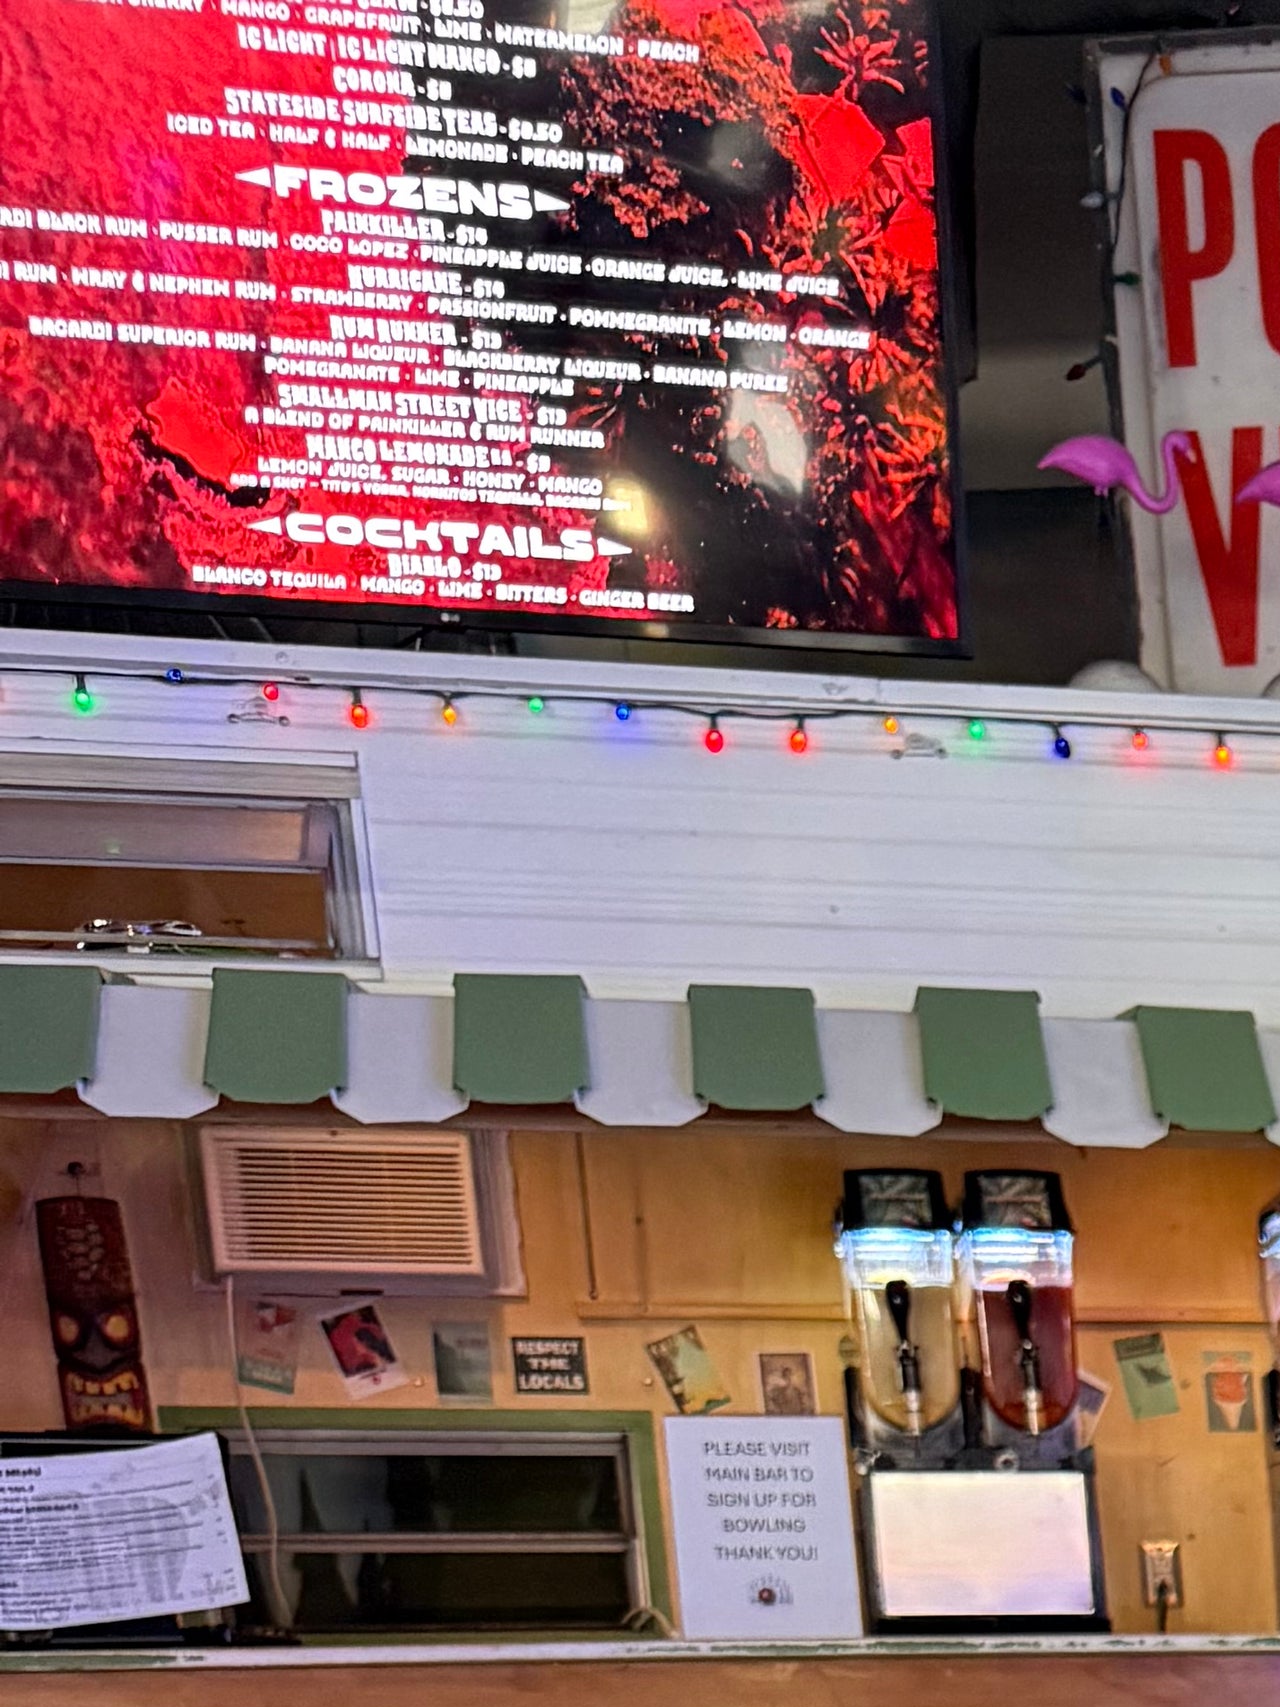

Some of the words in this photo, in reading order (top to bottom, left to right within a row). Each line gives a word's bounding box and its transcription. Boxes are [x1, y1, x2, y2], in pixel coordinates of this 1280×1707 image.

[220, 0, 290, 21] MANGO
[305, 7, 421, 35] GRAPEFRUIT
[434, 18, 482, 41] LIME
[495, 21, 623, 56] WATERMELON
[638, 38, 699, 63] PEACH
[263, 24, 327, 57] LIGHT
[363, 37, 426, 68] LIGHT
[427, 41, 501, 75] MANGO
[333, 65, 416, 98] CORONA
[223, 86, 342, 122] STATESIDE
[342, 99, 443, 132] SURFSIDE
[443, 107, 498, 137] TEAS
[166, 111, 213, 136] ICED
[217, 116, 256, 140] TEA
[269, 121, 319, 145] HALF
[342, 130, 391, 152] HALF
[405, 135, 508, 164] LEMONADE
[522, 146, 583, 170] PEACH
[587, 151, 624, 175] TEA
[273, 163, 534, 220] FROZENS
[321, 208, 446, 243] PAINKILLER
[37, 208, 101, 235] BLACK
[104, 215, 148, 238] RUM
[159, 219, 233, 245] PUSSER
[236, 226, 278, 249] RUM
[290, 233, 343, 254] COCO
[348, 238, 409, 260] LOPEZ
[421, 245, 523, 270] PINEAPPLE
[526, 251, 582, 275] JUICE
[592, 257, 665, 282] ORANGE
[738, 271, 782, 292] LIME
[786, 273, 839, 296] JUICE
[347, 265, 462, 295] HURRICANE
[13, 260, 57, 284] RUM
[71, 265, 127, 290] WRAY
[149, 272, 230, 298] NEPHEW
[234, 280, 277, 301] RUM
[291, 285, 412, 312] STRAWBERRY
[428, 296, 557, 323] PASSIONFRUIT
[570, 306, 711, 336] POMMEGRANITE
[723, 319, 787, 342] LEMON
[799, 326, 871, 350] ORANGE
[329, 314, 374, 341] RUM
[376, 318, 458, 347] RUNNER
[28, 314, 113, 341] BACARDI
[116, 322, 210, 348] SUPERIOR
[214, 330, 257, 352] RUM
[270, 335, 347, 359] BANANA
[352, 341, 430, 365] LIQUEUR
[443, 348, 560, 376] BLACKBERRY
[564, 357, 642, 383] LIQUEUR
[653, 363, 727, 389] BANANA
[730, 371, 788, 392] PUREE
[264, 354, 401, 384] POMEGRANATE
[414, 367, 460, 389] LIME
[473, 371, 574, 397] PINEAPPLE
[278, 383, 393, 413] SMALLMAN
[395, 391, 471, 418] STREET
[472, 395, 522, 424] VICE
[244, 406, 259, 424] A
[262, 407, 324, 429] BLEND
[328, 412, 354, 431] OF
[358, 414, 466, 439] PAINKILLER
[485, 423, 526, 442] RUM
[530, 427, 605, 450] RUNNER
[305, 433, 377, 463] MANGO
[378, 439, 490, 467] LEMONADE
[257, 455, 323, 477] LEMON
[391, 465, 450, 486] SUGAR
[462, 470, 526, 492] HONEY
[538, 474, 603, 497] MANGO
[285, 511, 595, 562] COCKTAILS
[388, 552, 461, 580] DIABLO
[192, 565, 267, 587] BLANCO
[270, 570, 347, 590] TEQUILA
[360, 575, 425, 596] MANGO
[438, 581, 483, 600] LIME
[496, 584, 567, 604] BITTERS
[579, 589, 645, 609] GINGER
[647, 592, 695, 613] BEER
[519, 1374, 584, 1390] LOCALS
[704, 1442, 767, 1457] PLEASE
[770, 1441, 810, 1456] VISIT
[705, 1467, 750, 1482] MAIN
[754, 1468, 789, 1482] BAR
[791, 1468, 814, 1482] TO
[707, 1493, 750, 1507] SIGN
[753, 1494, 778, 1507] UP
[781, 1494, 816, 1507] FOR
[723, 1518, 806, 1533] BOWLING
[713, 1546, 774, 1561] THANK
[776, 1547, 819, 1561] YOU!
